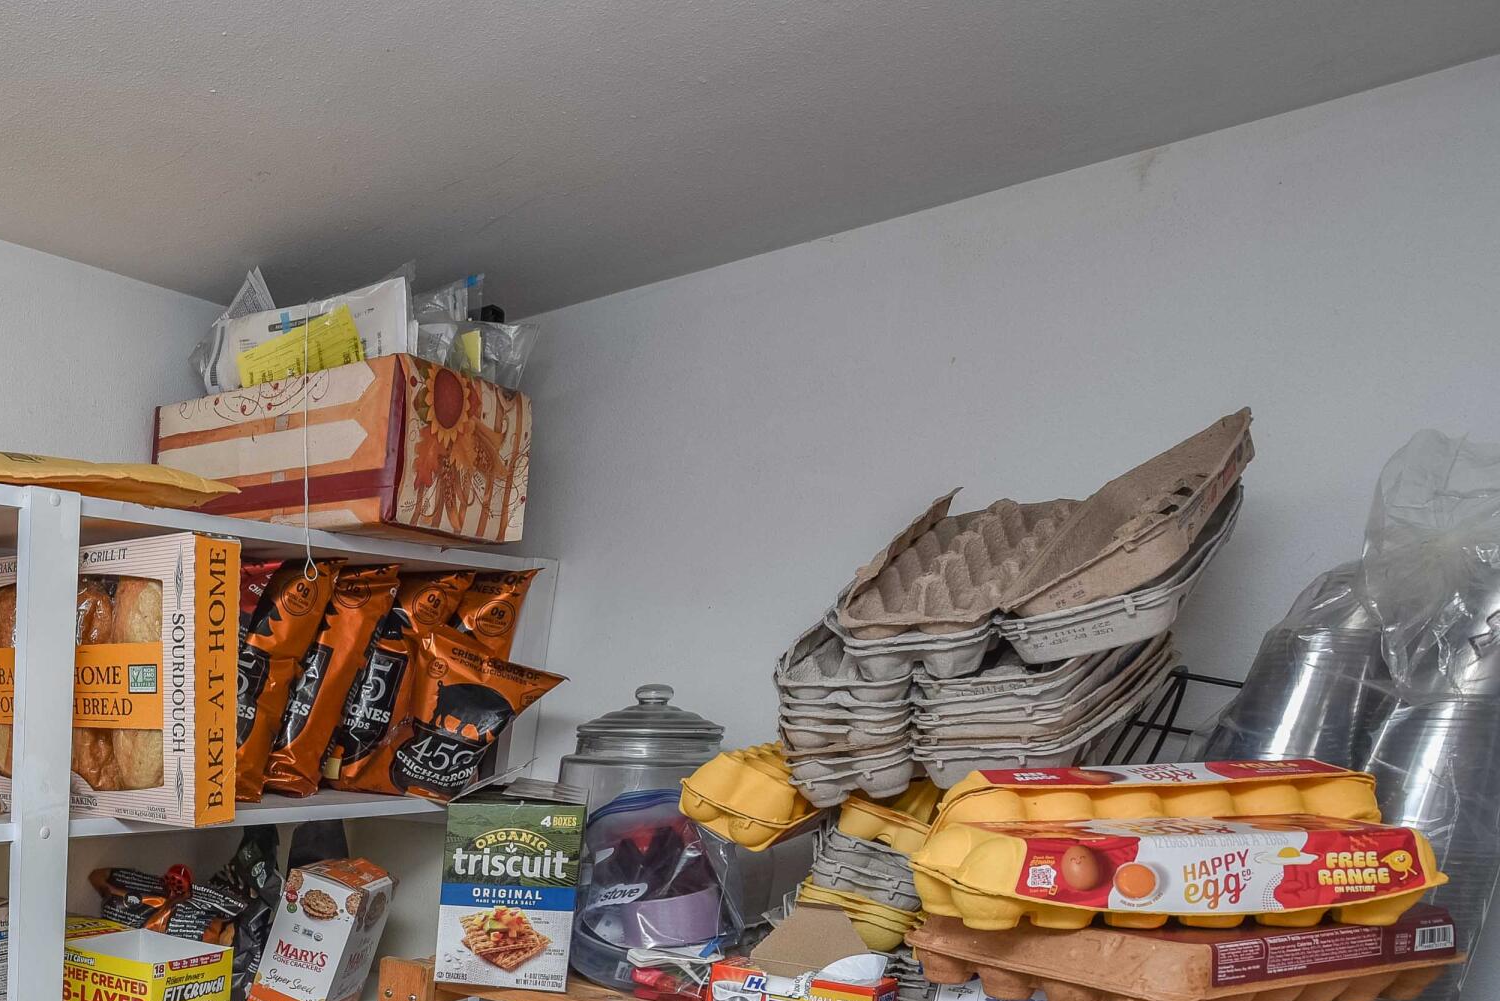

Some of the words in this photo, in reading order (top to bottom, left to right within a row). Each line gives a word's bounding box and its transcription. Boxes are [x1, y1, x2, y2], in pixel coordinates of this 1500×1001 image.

[90, 550, 116, 563] GRILL
[171, 613, 186, 754] SOURDOUGH
[83, 698, 133, 715] BREAD
[540, 815, 551, 827] 4
[552, 815, 577, 827] BOXES
[475, 828, 548, 850] ORGANIC
[453, 847, 569, 879] triscuit
[1183, 849, 1250, 882] HAPPY
[1325, 850, 1381, 869] FREE
[1317, 867, 1391, 886] RANGE
[472, 887, 542, 901] ORIGINAL
[1182, 871, 1247, 910] egg
[1334, 885, 1345, 893] ON
[1345, 884, 1376, 893] PASTURE
[275, 938, 329, 968] MARY'S
[154, 964, 165, 974] 18
[272, 954, 290, 965] GONE
[289, 960, 322, 973] CRACKERS
[91, 972, 148, 996] CREATED
[266, 969, 291, 985] Super
